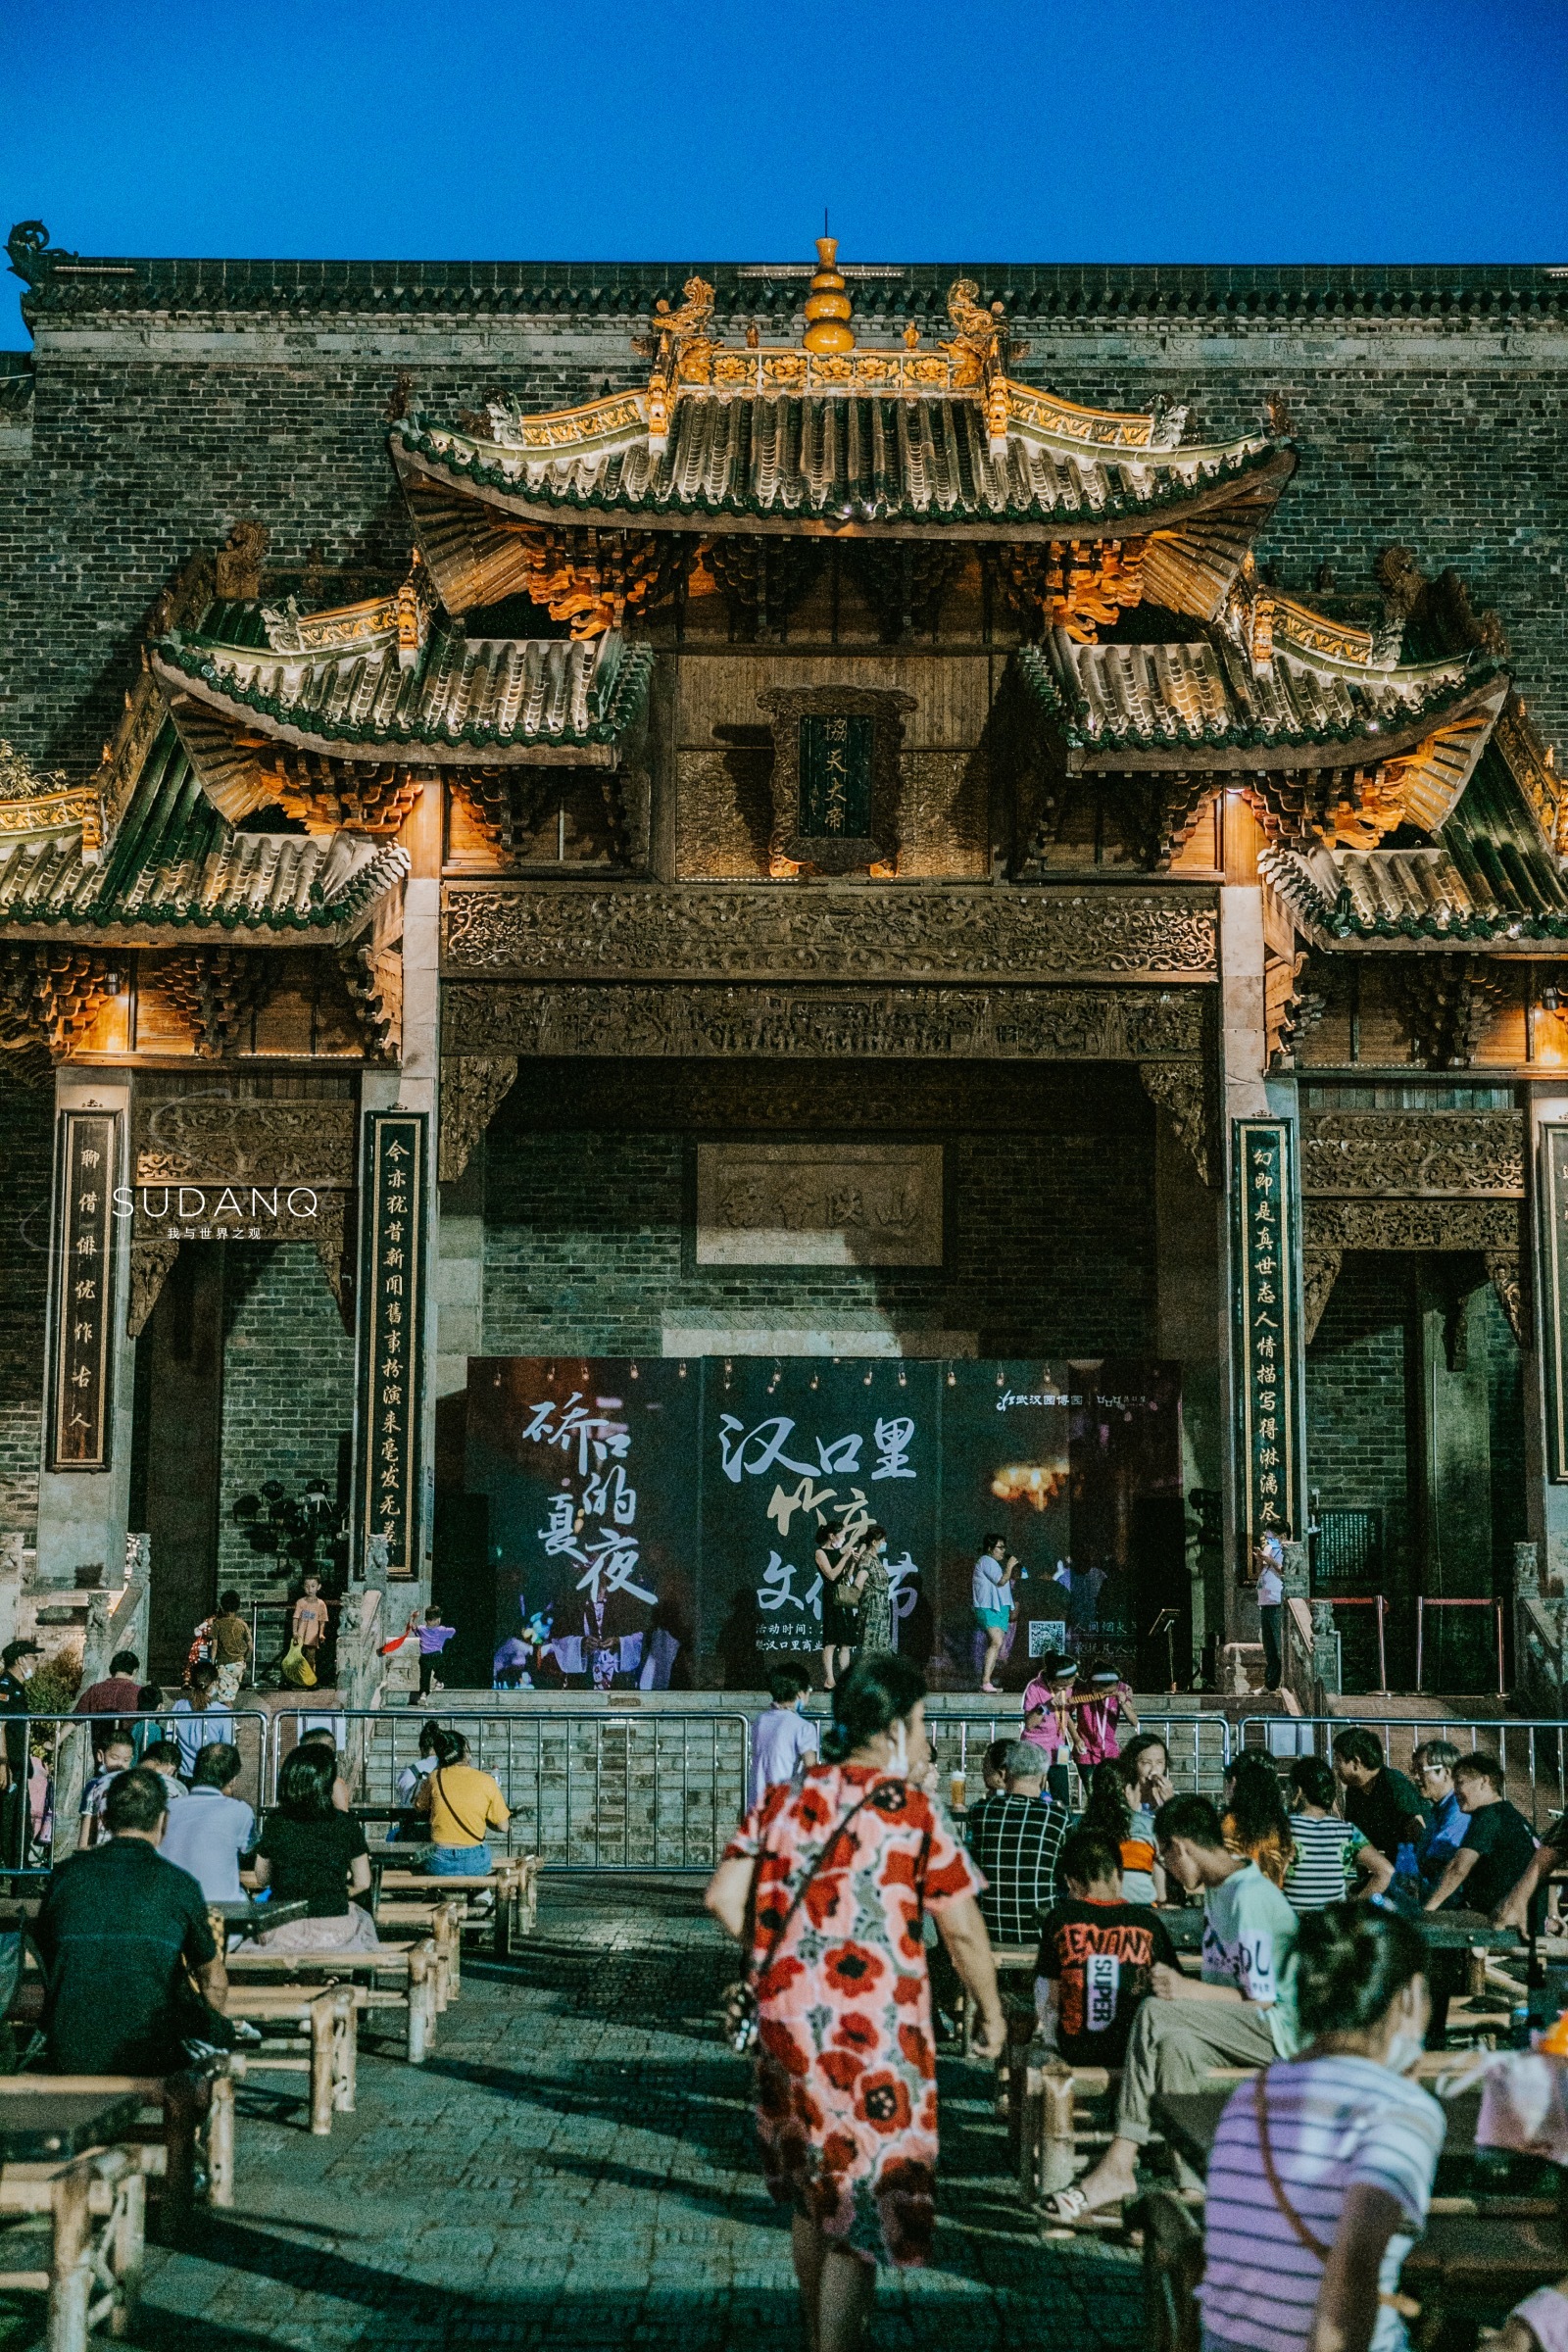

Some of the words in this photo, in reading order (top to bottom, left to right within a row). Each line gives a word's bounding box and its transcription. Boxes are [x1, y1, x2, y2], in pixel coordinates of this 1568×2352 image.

[718, 1413, 917, 1483] 汉口里
[1093, 1959, 1112, 2022] SUPER
